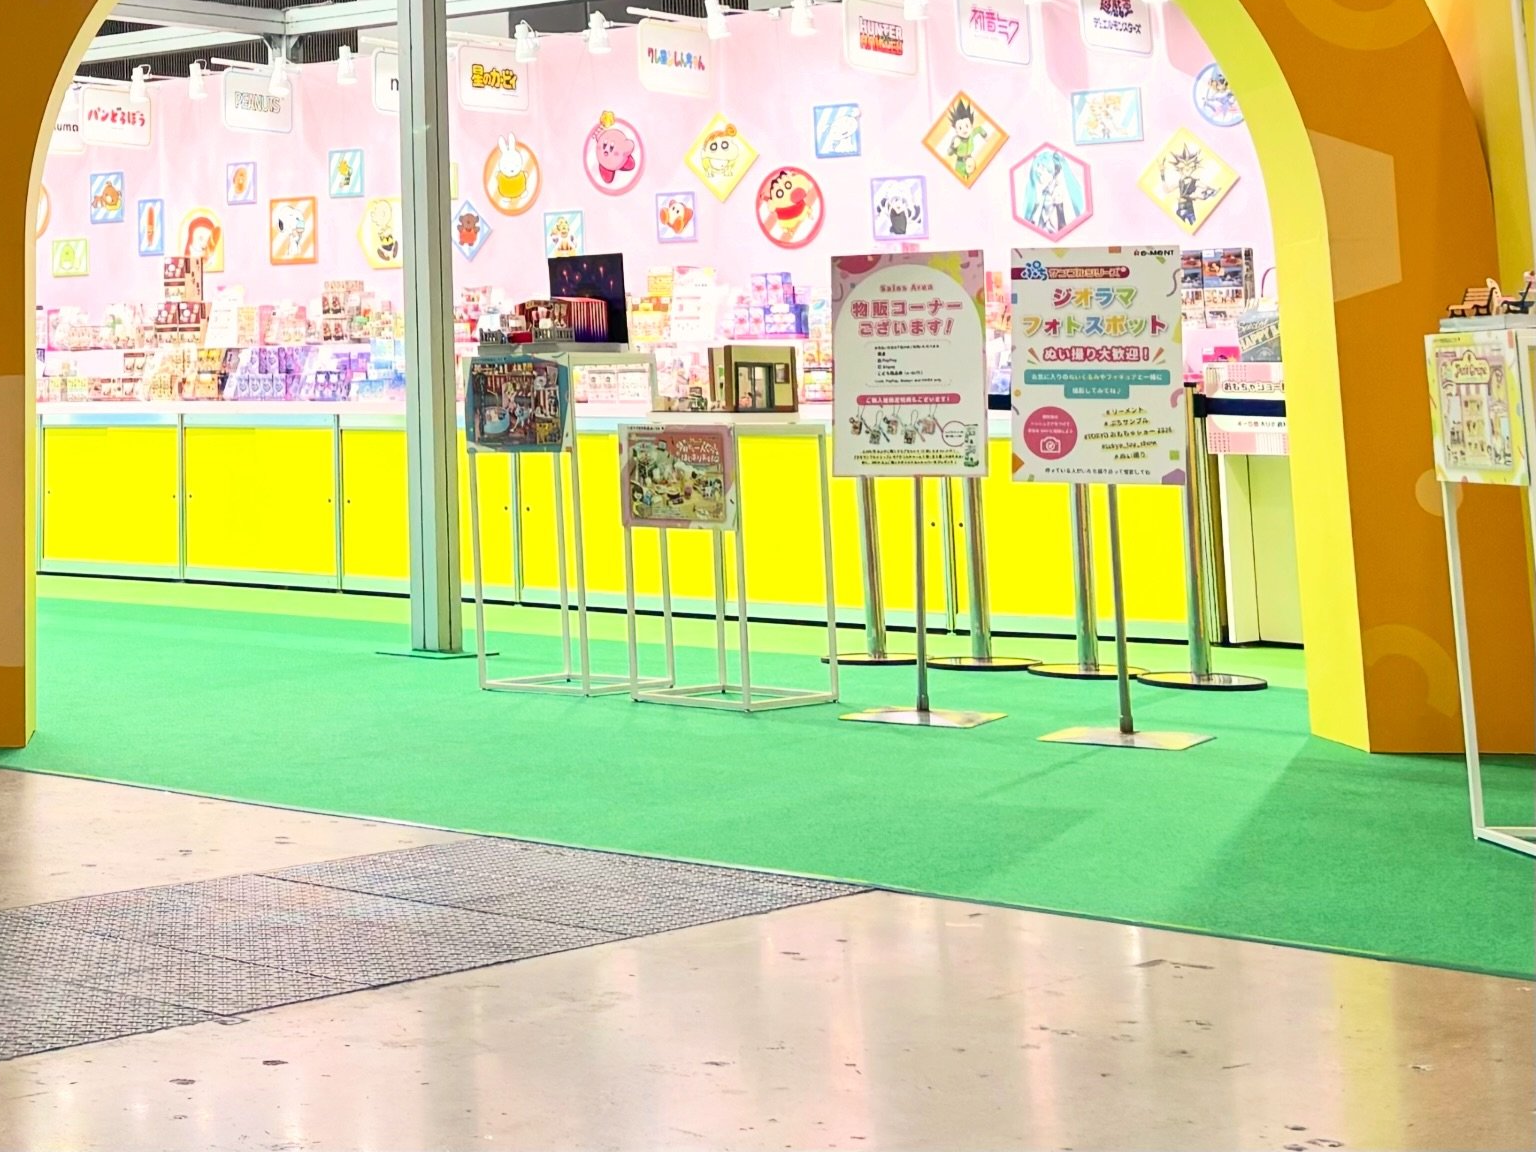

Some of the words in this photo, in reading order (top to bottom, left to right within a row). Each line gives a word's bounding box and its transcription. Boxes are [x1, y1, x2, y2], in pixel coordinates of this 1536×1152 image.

[969, 5, 1019, 45] 初音ミク
[234, 91, 281, 114] PEANUTS
[88, 107, 145, 127] パンどろぼう
[880, 284, 907, 292] Sales
[910, 283, 933, 292] Area
[1053, 287, 1137, 308] ジオラマ
[851, 298, 962, 319] 物販コーナー
[859, 318, 954, 337] ございます!
[1022, 314, 1168, 337] フォトスポット
